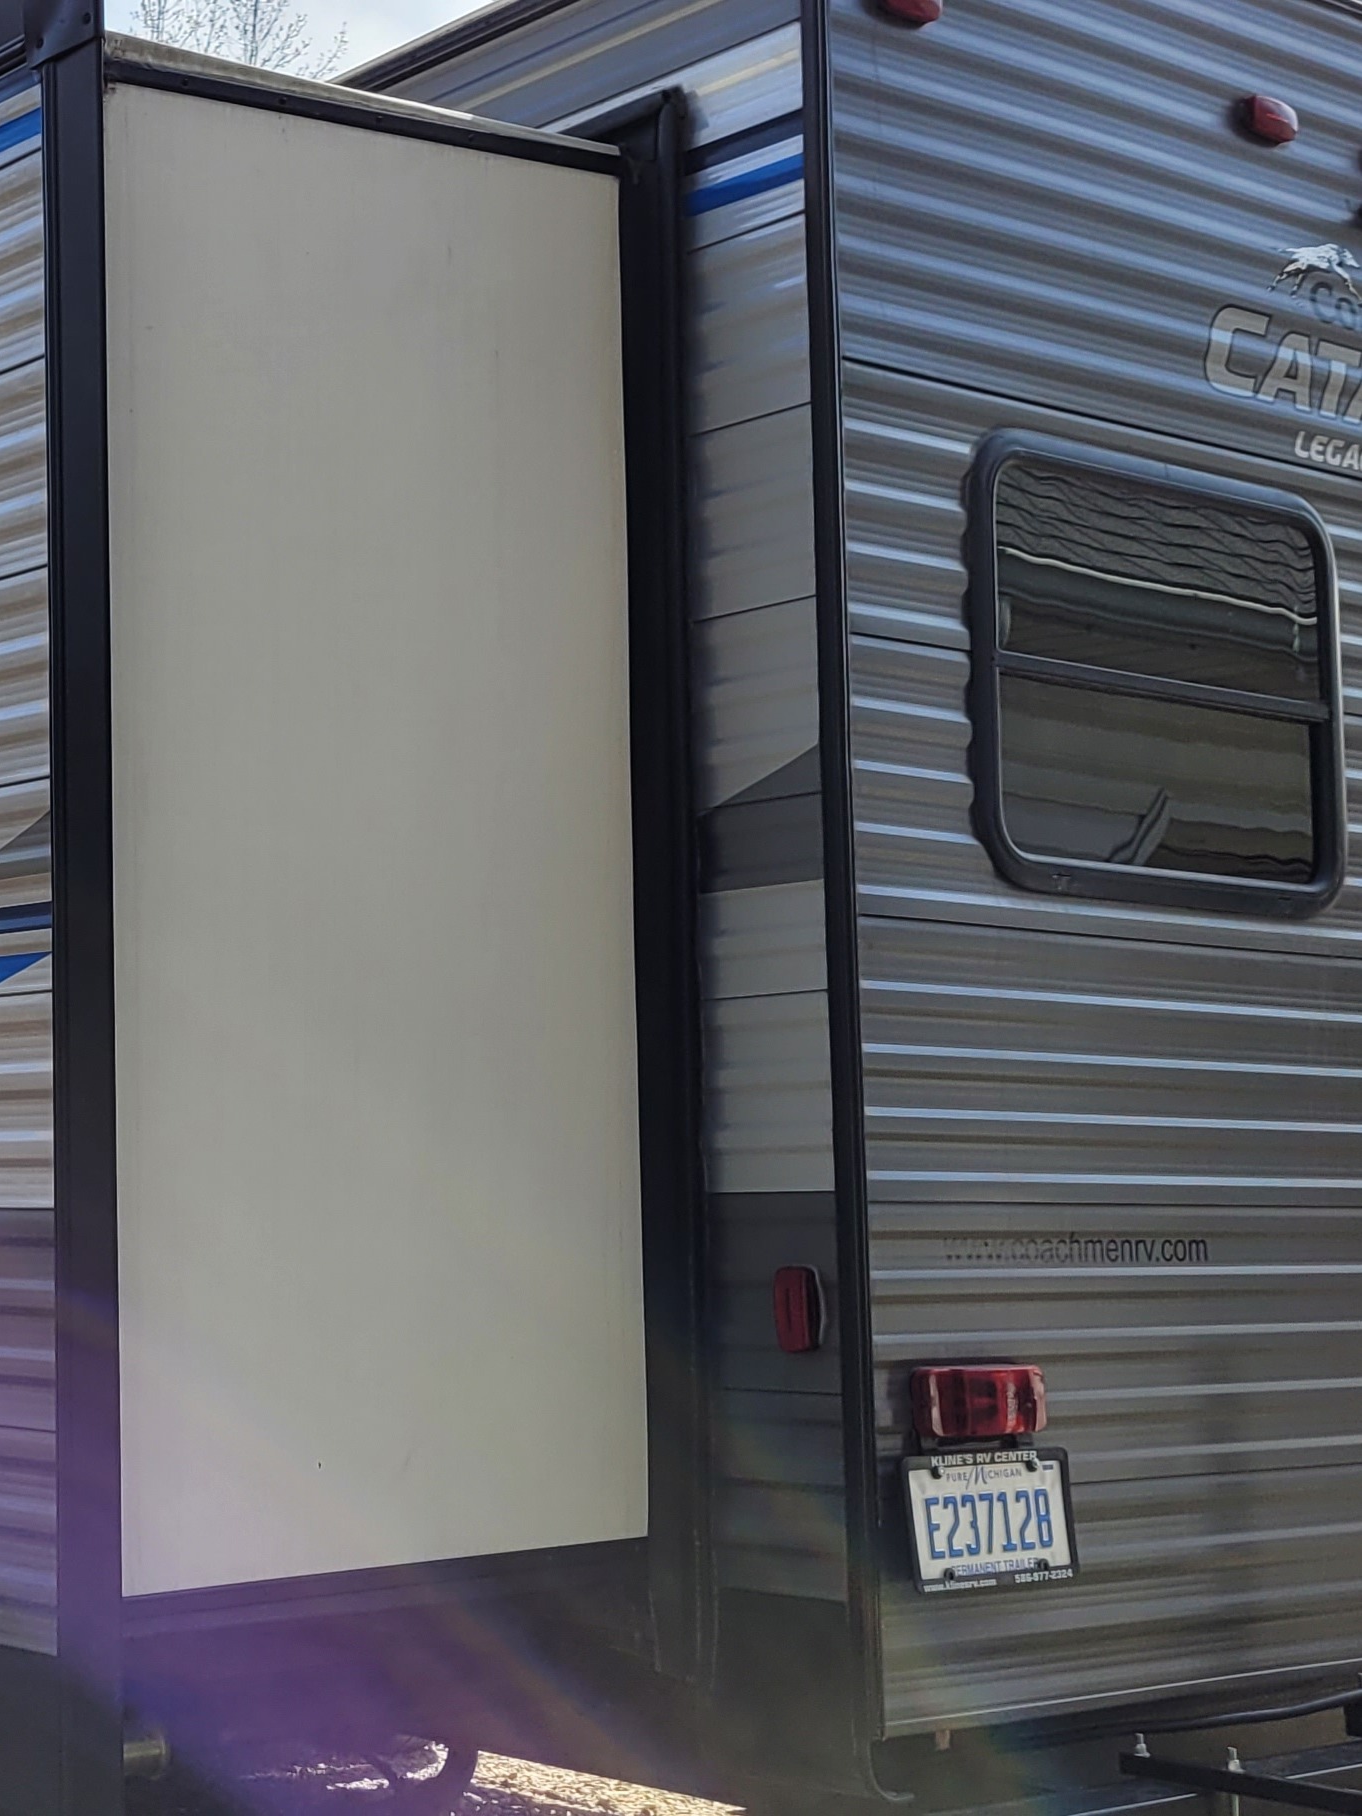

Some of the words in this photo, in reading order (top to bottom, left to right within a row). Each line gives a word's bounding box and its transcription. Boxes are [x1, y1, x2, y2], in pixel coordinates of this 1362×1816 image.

[1295, 430, 1362, 471] LEGA
[931, 1455, 974, 1467] KLINE'S
[976, 1452, 992, 1464] RV
[994, 1450, 1037, 1463] CENTER
[946, 1472, 968, 1483] PURE
[925, 1489, 1054, 1560] E237128
